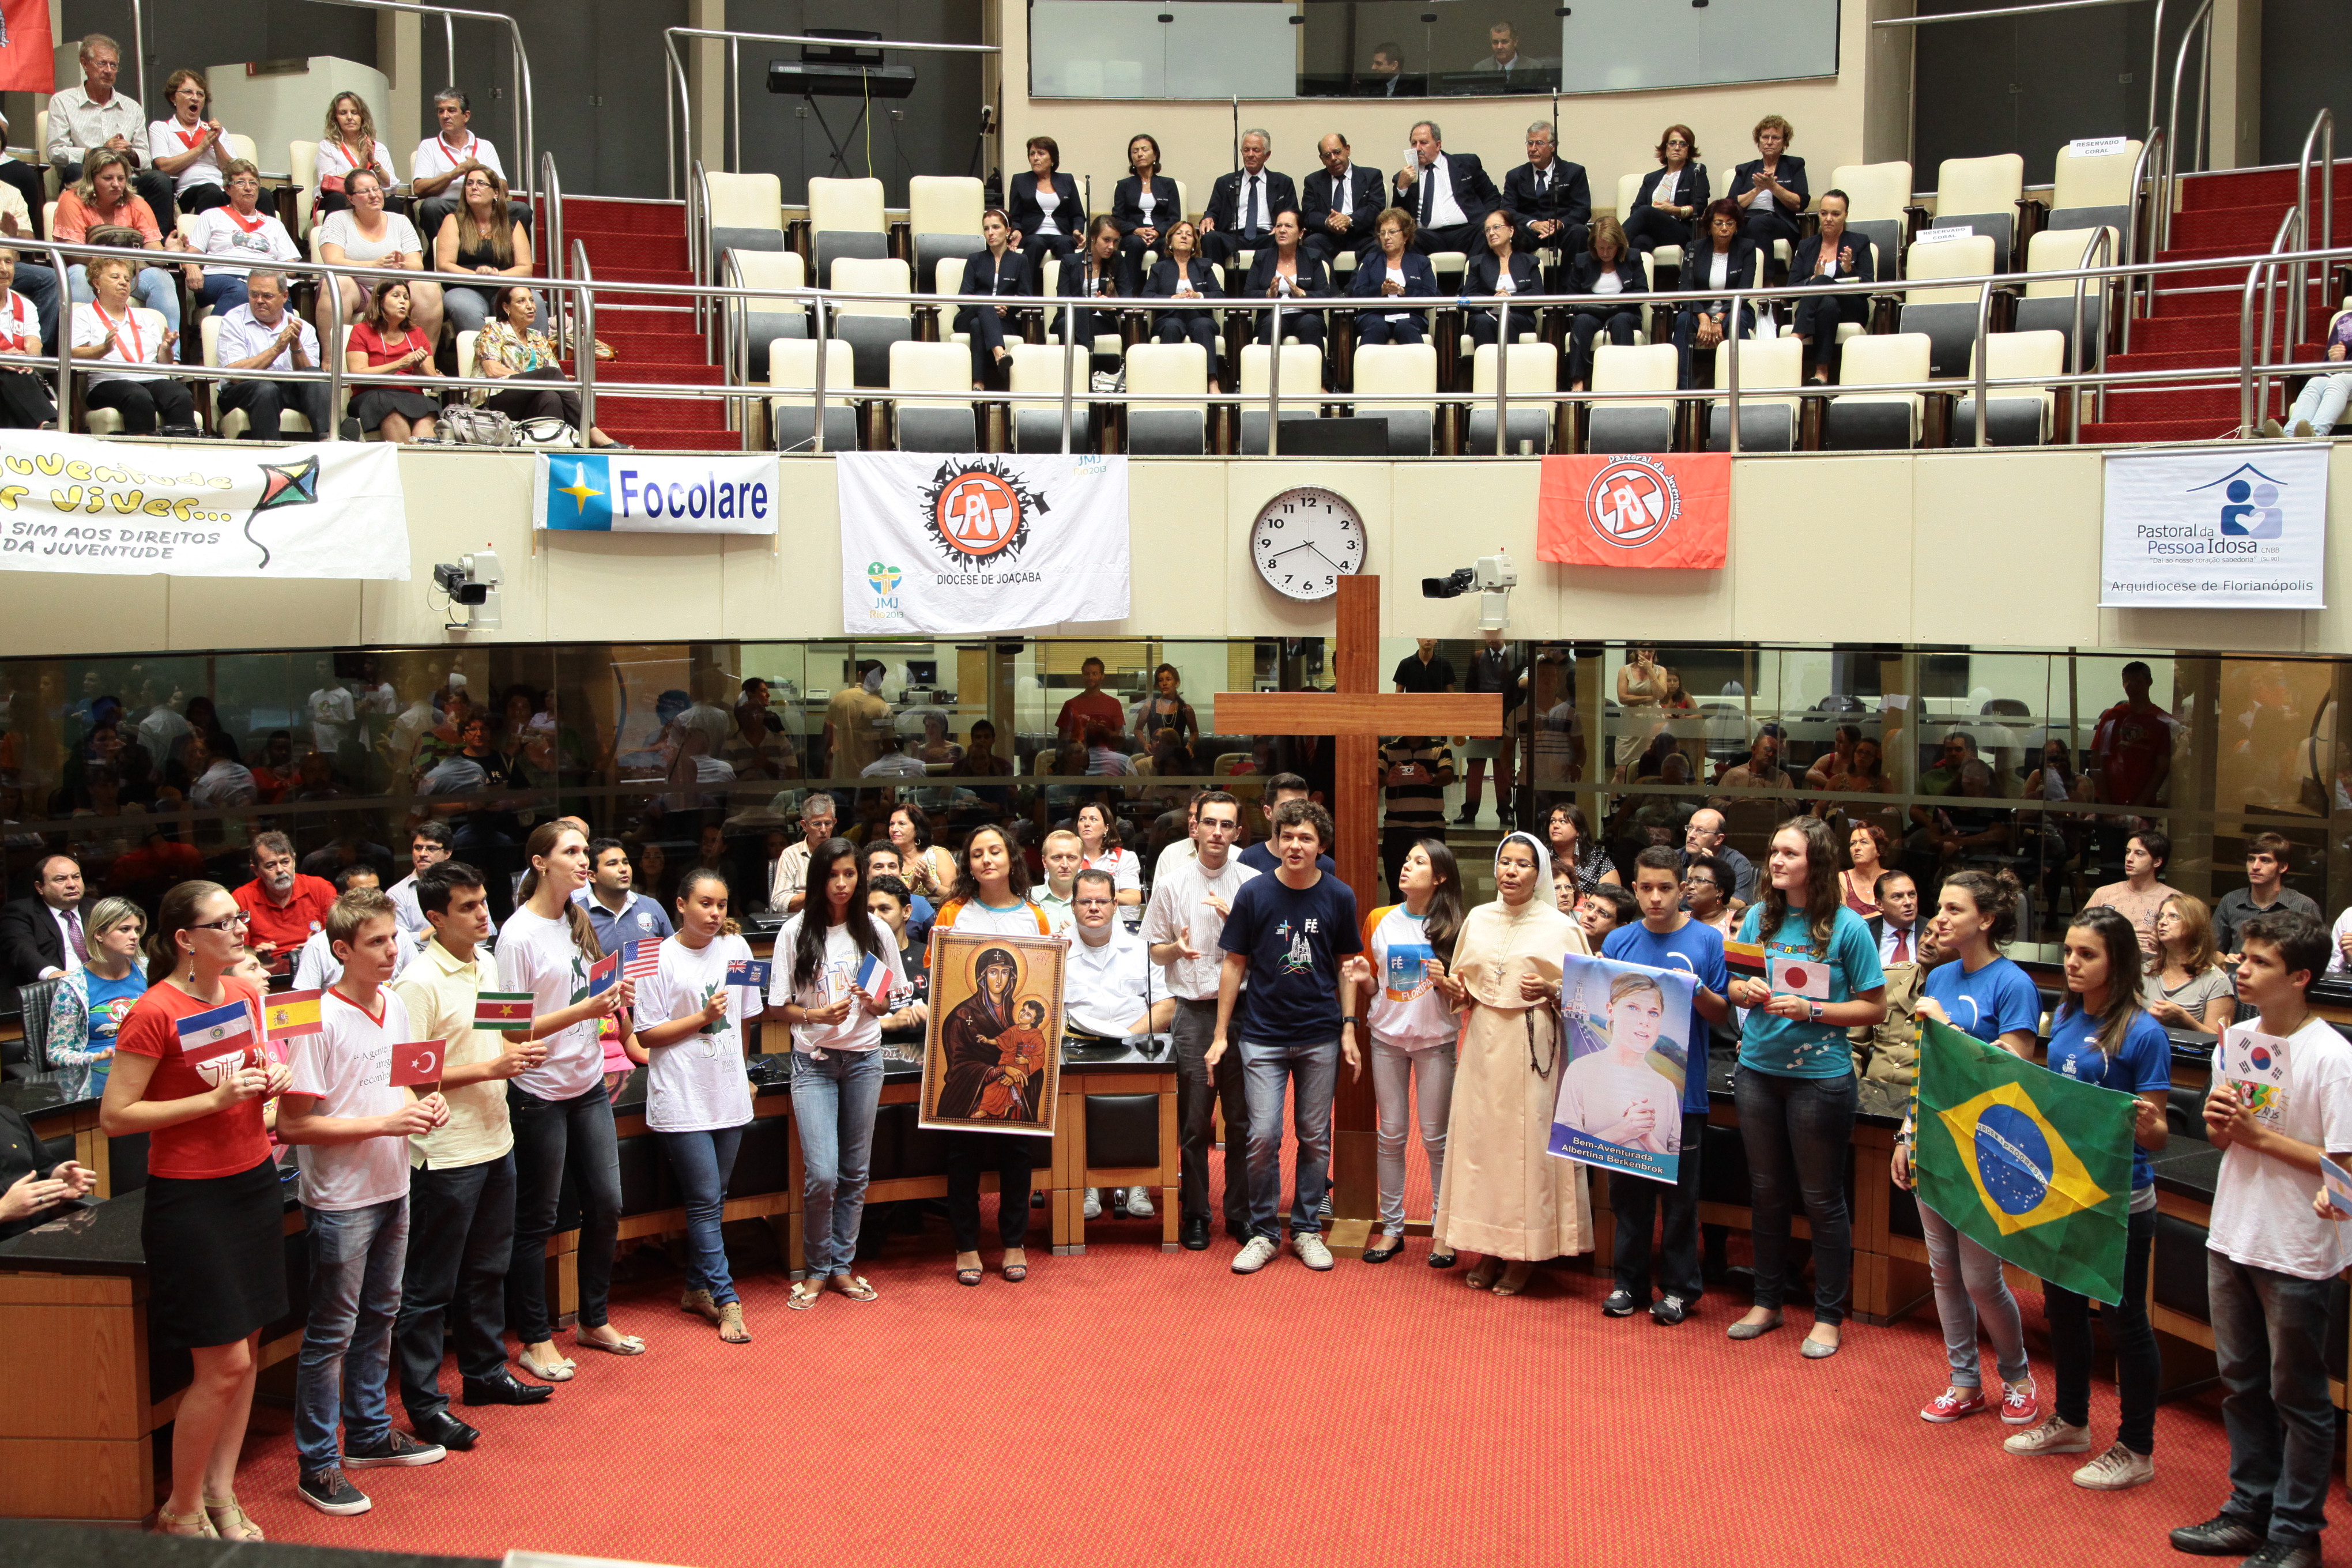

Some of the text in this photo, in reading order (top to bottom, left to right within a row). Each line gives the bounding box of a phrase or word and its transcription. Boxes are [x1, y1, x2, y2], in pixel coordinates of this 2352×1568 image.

[2076, 140, 2119, 148] RESERVADO
[1923, 227, 1966, 235] RESERVADO
[1078, 455, 1101, 466] JMJ
[0, 453, 233, 490] uventude
[1653, 461, 1665, 473] da
[620, 470, 768, 519] Focolare
[1301, 497, 1317, 507] 12
[1283, 504, 1294, 514] 11
[1326, 505, 1332, 514] 1
[1268, 519, 1284, 529] 10
[1340, 521, 1350, 529] 2
[12, 522, 220, 544] SIM AOS DIREITOS
[2137, 523, 2214, 538] Pastoral da
[3, 538, 175, 559] DA JUVENTUDE
[1261, 539, 1271, 548] 9
[1346, 540, 1355, 549] 3
[2147, 537, 2257, 555] Pessoa Idosa
[1268, 559, 1277, 568] 8
[2195, 556, 2220, 564] coração
[1339, 561, 1349, 570] 4
[937, 572, 1042, 586] DIOCESE DE JOAÇABA
[1284, 575, 1294, 583] 7
[1325, 575, 1333, 585] 5
[1303, 581, 1313, 590] 6
[2110, 578, 2313, 594] Arquidiocese de Florianópolis
[875, 597, 898, 609] JMJ
[1401, 978, 1434, 1001] FLORIPA
[1573, 1136, 1654, 1162] Bem-Aventurada
[1561, 1144, 1664, 1175] Albertina Berkenbrok
[1978, 1124, 1998, 1140] ORDEM
[2003, 1143, 2046, 1186] PROGRESSO
